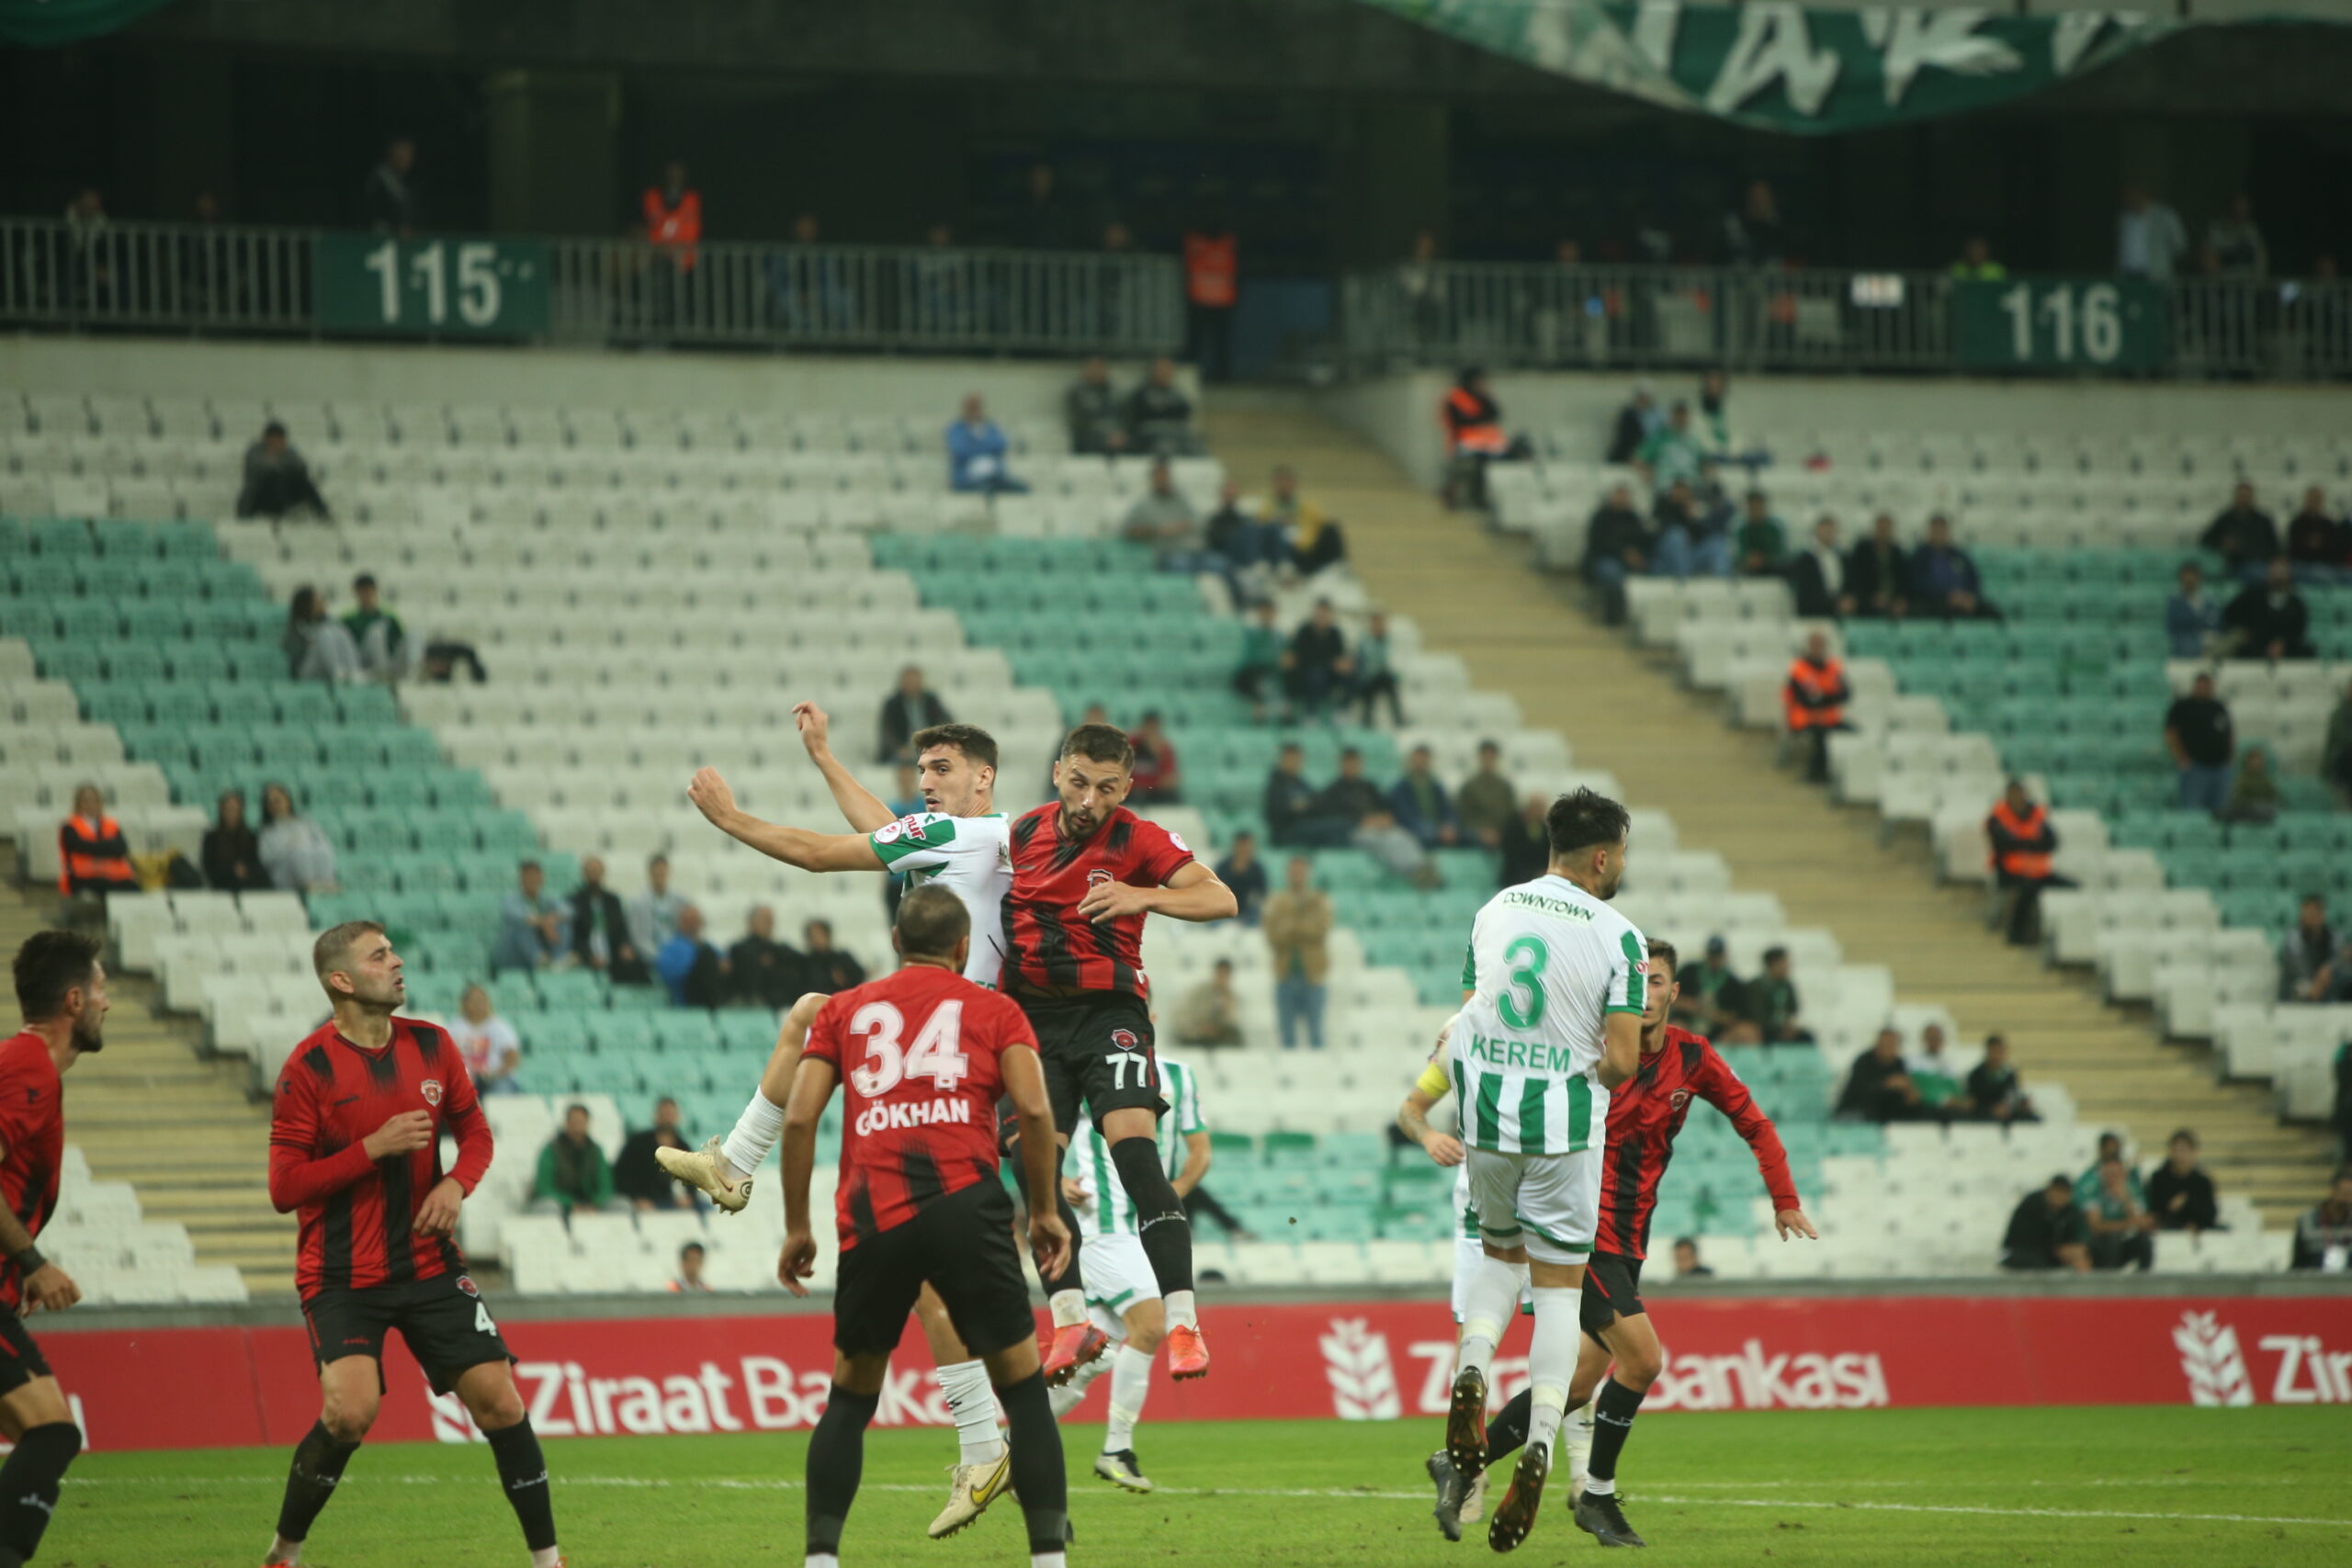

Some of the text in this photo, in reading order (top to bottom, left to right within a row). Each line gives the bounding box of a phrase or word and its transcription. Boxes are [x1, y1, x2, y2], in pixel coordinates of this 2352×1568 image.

[365, 239, 501, 327] 115
[2000, 280, 2121, 363] 116
[1503, 891, 1596, 920] DOWNTOWN
[1497, 933, 1549, 1031] 3
[850, 999, 968, 1098] 34
[1105, 1052, 1148, 1090] 77
[1470, 1033, 1571, 1073] KEREM
[855, 1099, 970, 1137] GÖKHAN
[475, 1302, 498, 1337] 4
[514, 1361, 743, 1435] Ziraat
